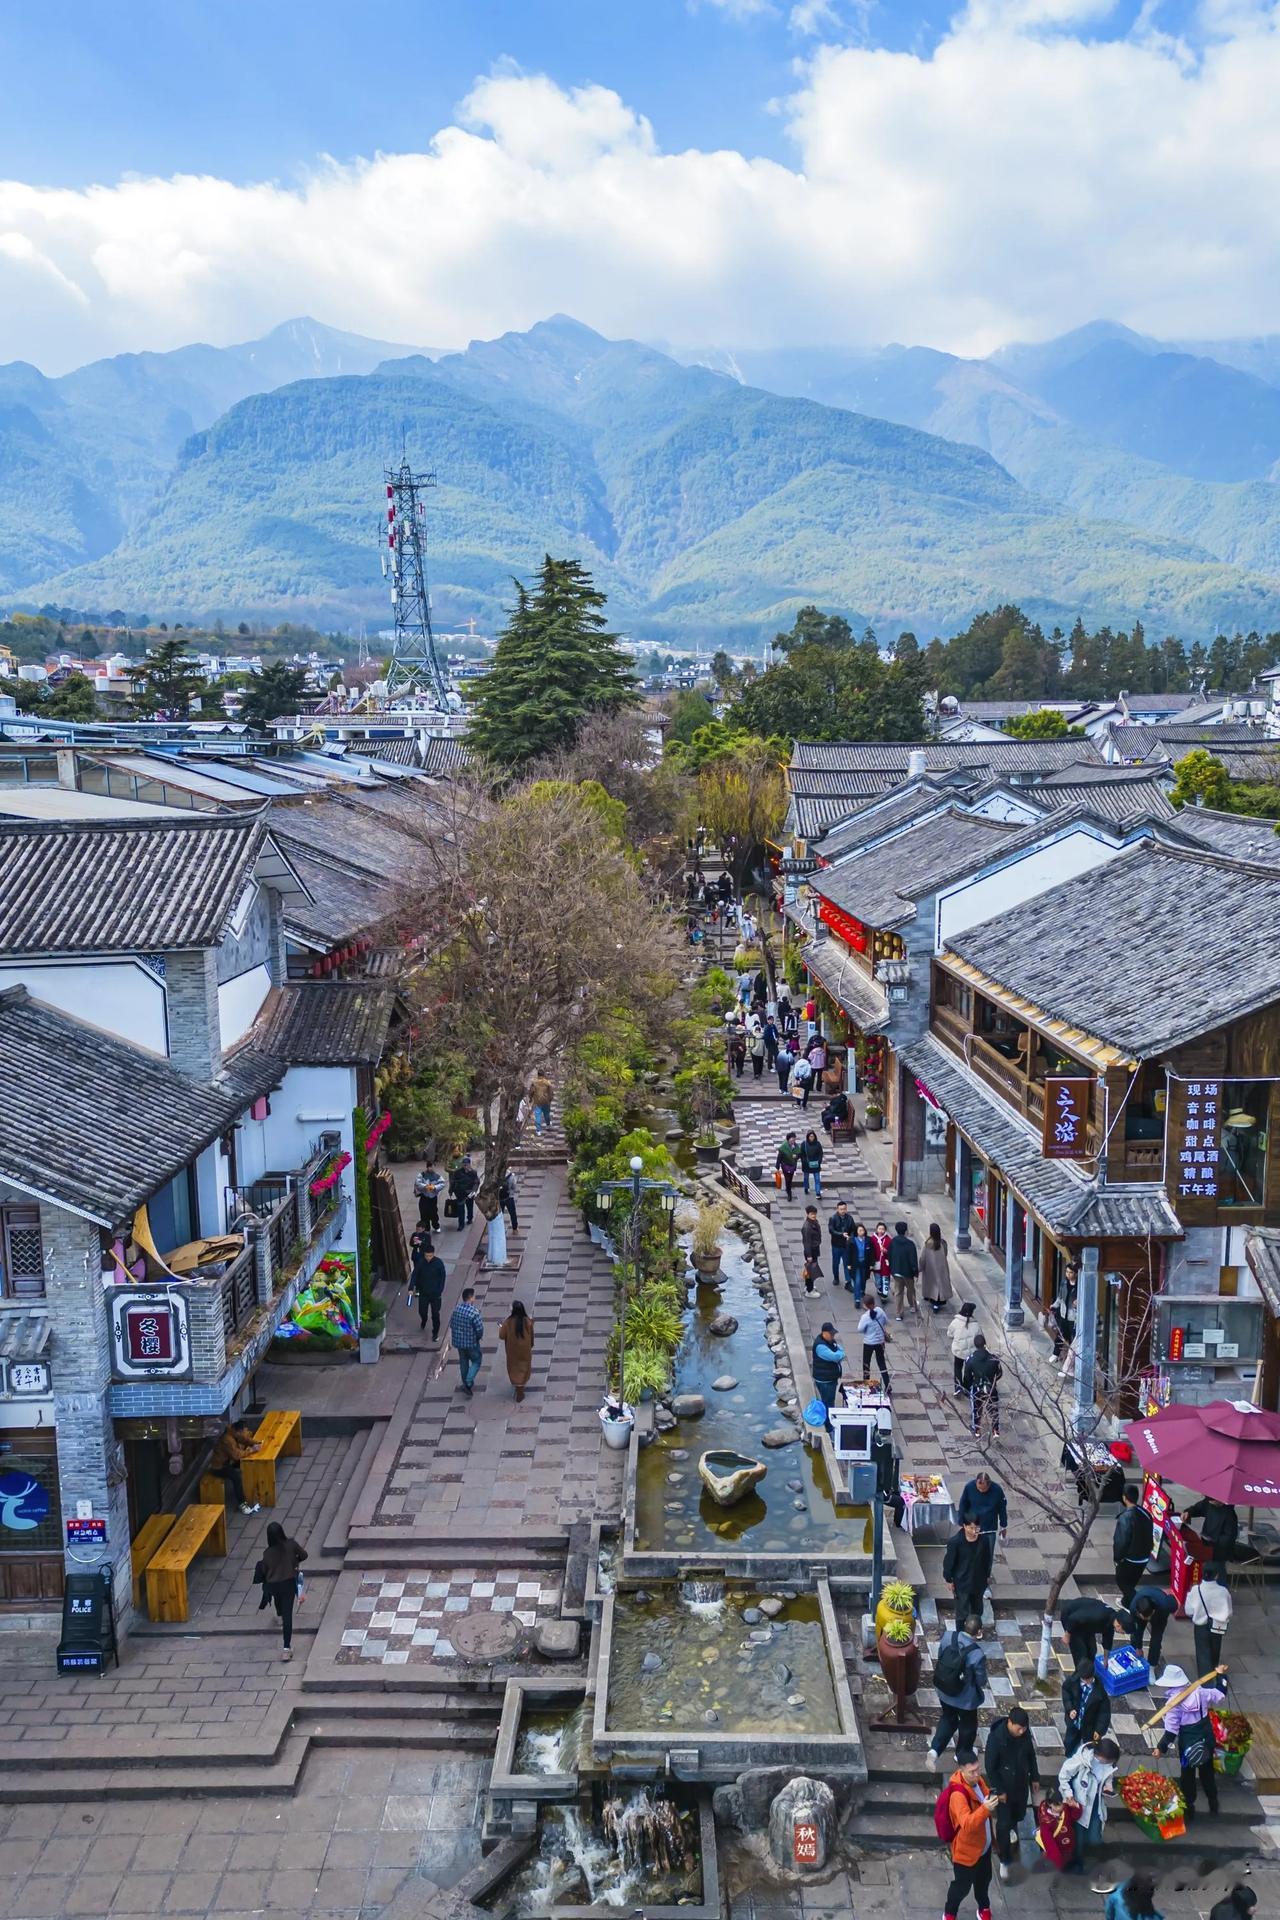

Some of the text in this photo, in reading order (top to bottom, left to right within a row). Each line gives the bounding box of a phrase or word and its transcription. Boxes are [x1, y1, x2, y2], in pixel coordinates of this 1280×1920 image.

[1187, 1084, 1218, 1096] 现场
[1186, 1101, 1216, 1115] 音乐
[1186, 1118, 1216, 1130] 咖啡
[1184, 1135, 1215, 1147] 甜点
[1180, 1150, 1219, 1163] 鸡尾酒
[1183, 1167, 1214, 1179] 精酿
[1179, 1183, 1217, 1196] 下午茶
